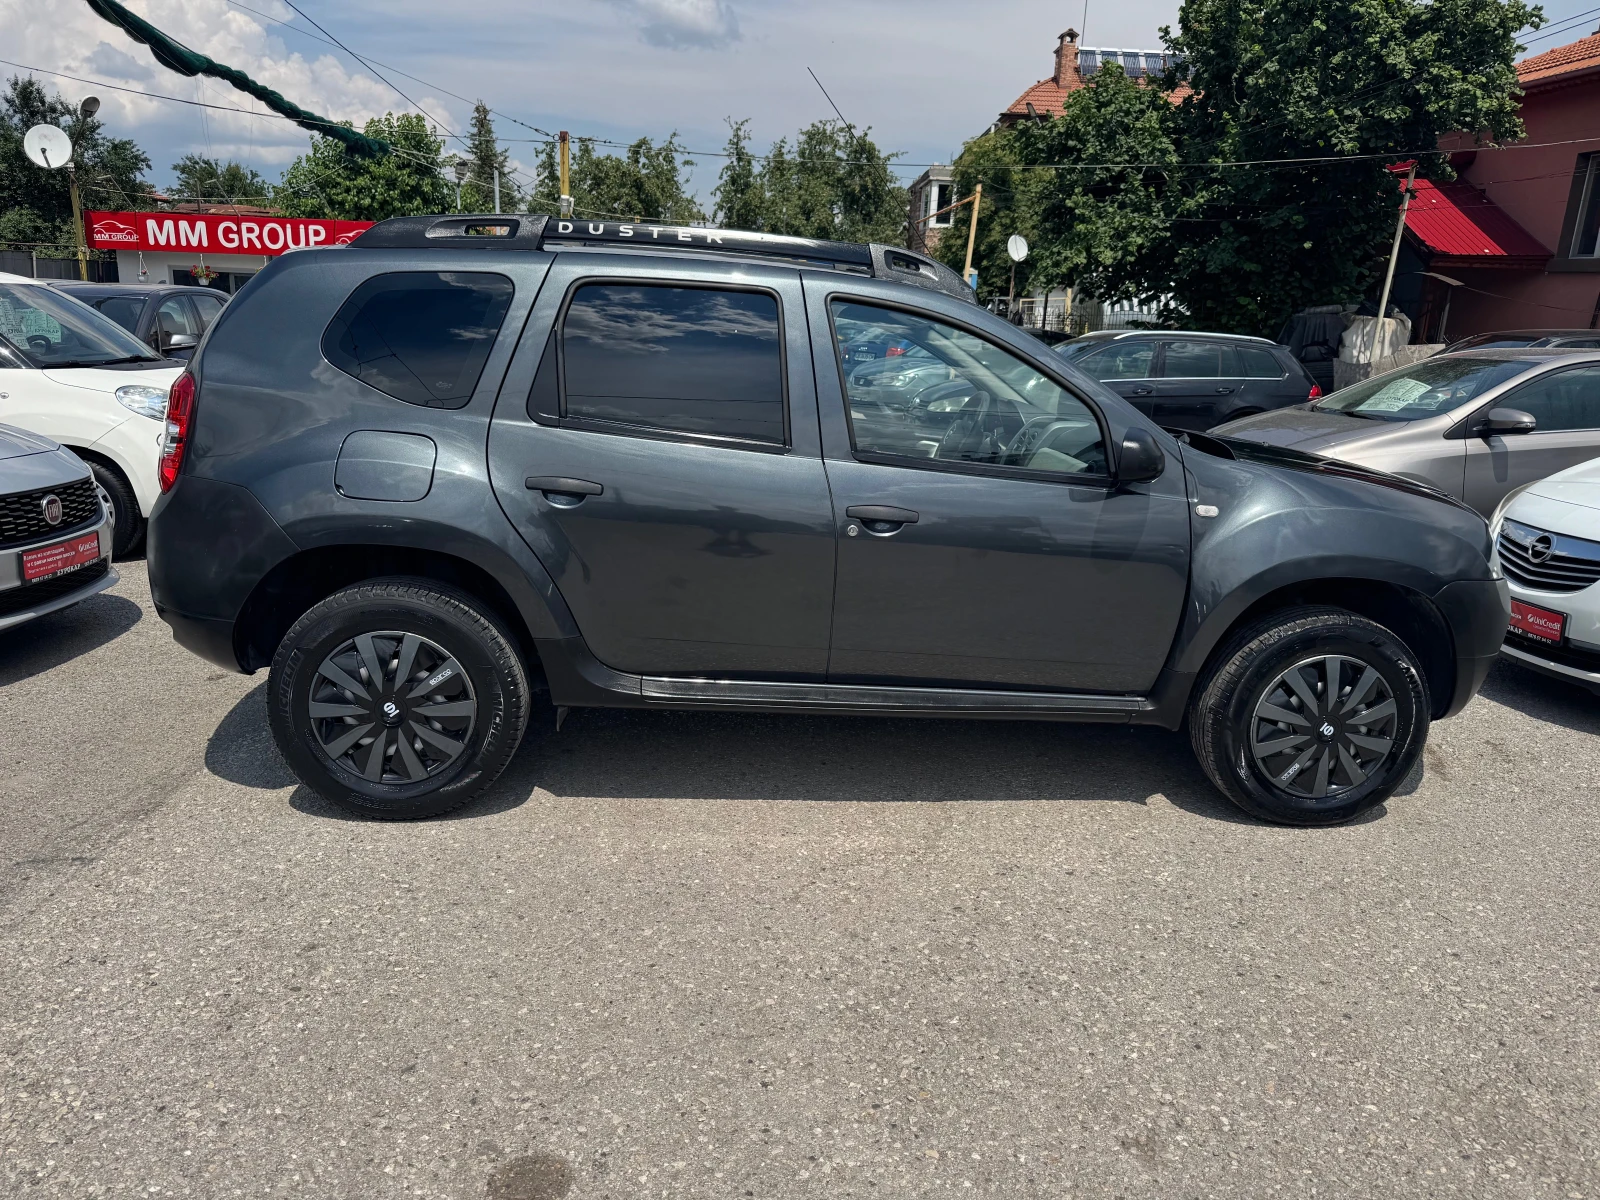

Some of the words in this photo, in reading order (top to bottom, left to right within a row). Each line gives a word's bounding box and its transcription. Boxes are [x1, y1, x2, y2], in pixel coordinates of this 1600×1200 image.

[146, 219, 208, 247] MM
[217, 221, 327, 250] GROUP
[558, 221, 723, 243] DUSTER
